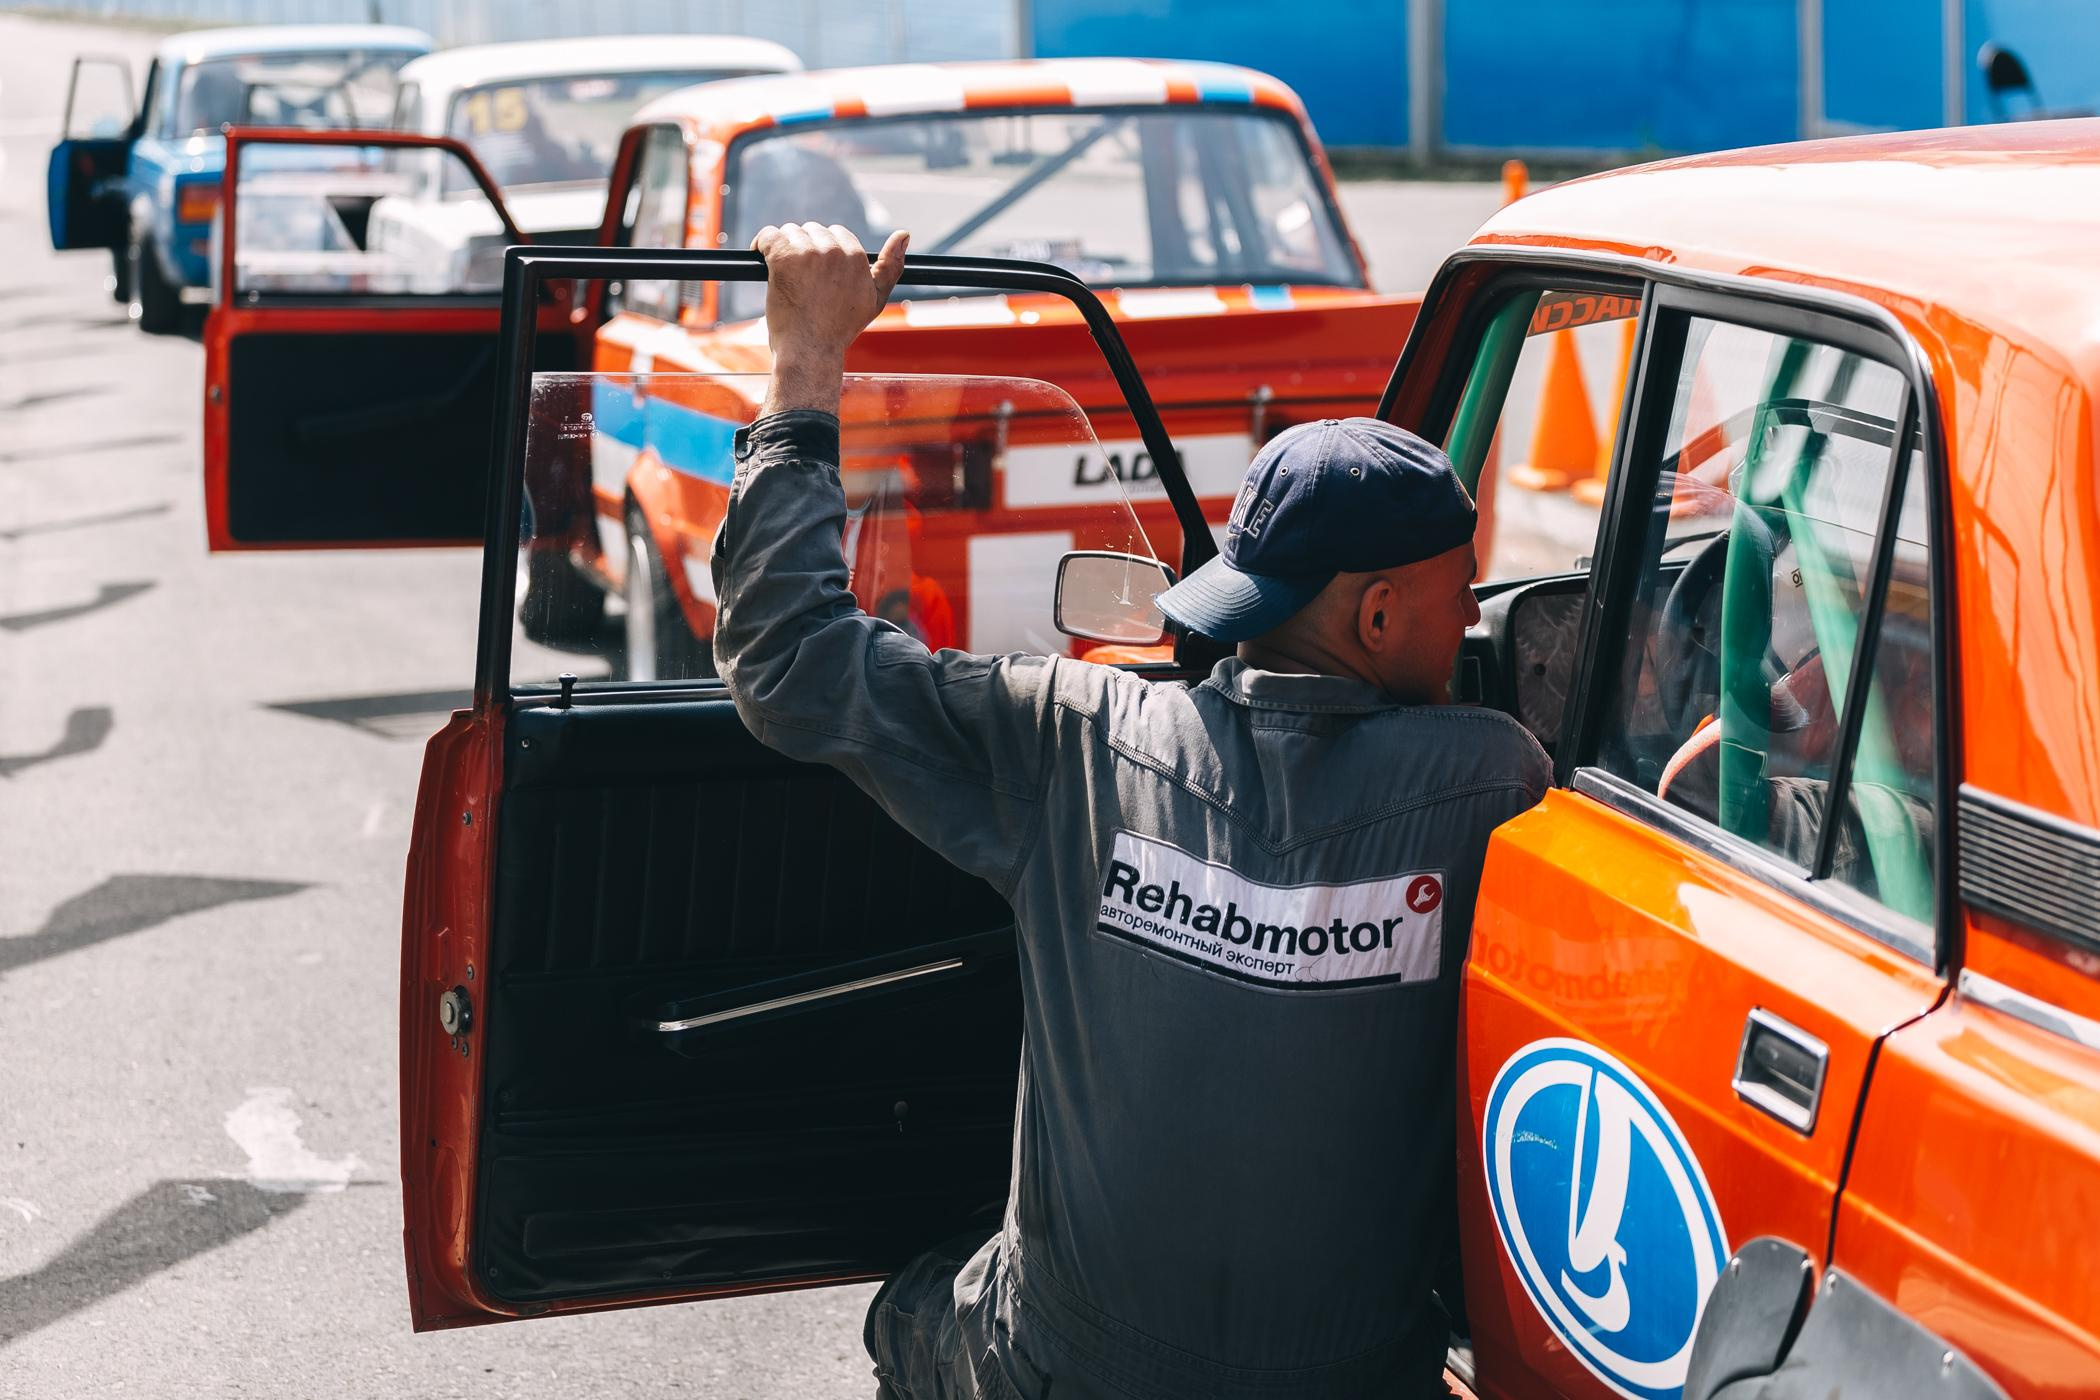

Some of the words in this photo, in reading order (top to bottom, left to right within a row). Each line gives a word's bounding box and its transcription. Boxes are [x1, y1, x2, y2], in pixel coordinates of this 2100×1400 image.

[466, 88, 528, 134] 15
[1074, 449, 1187, 487] LAD
[1102, 859, 1403, 957] Rehabmotor
[1100, 904, 1223, 958] авторемонтный
[1226, 950, 1295, 977] эксперт
